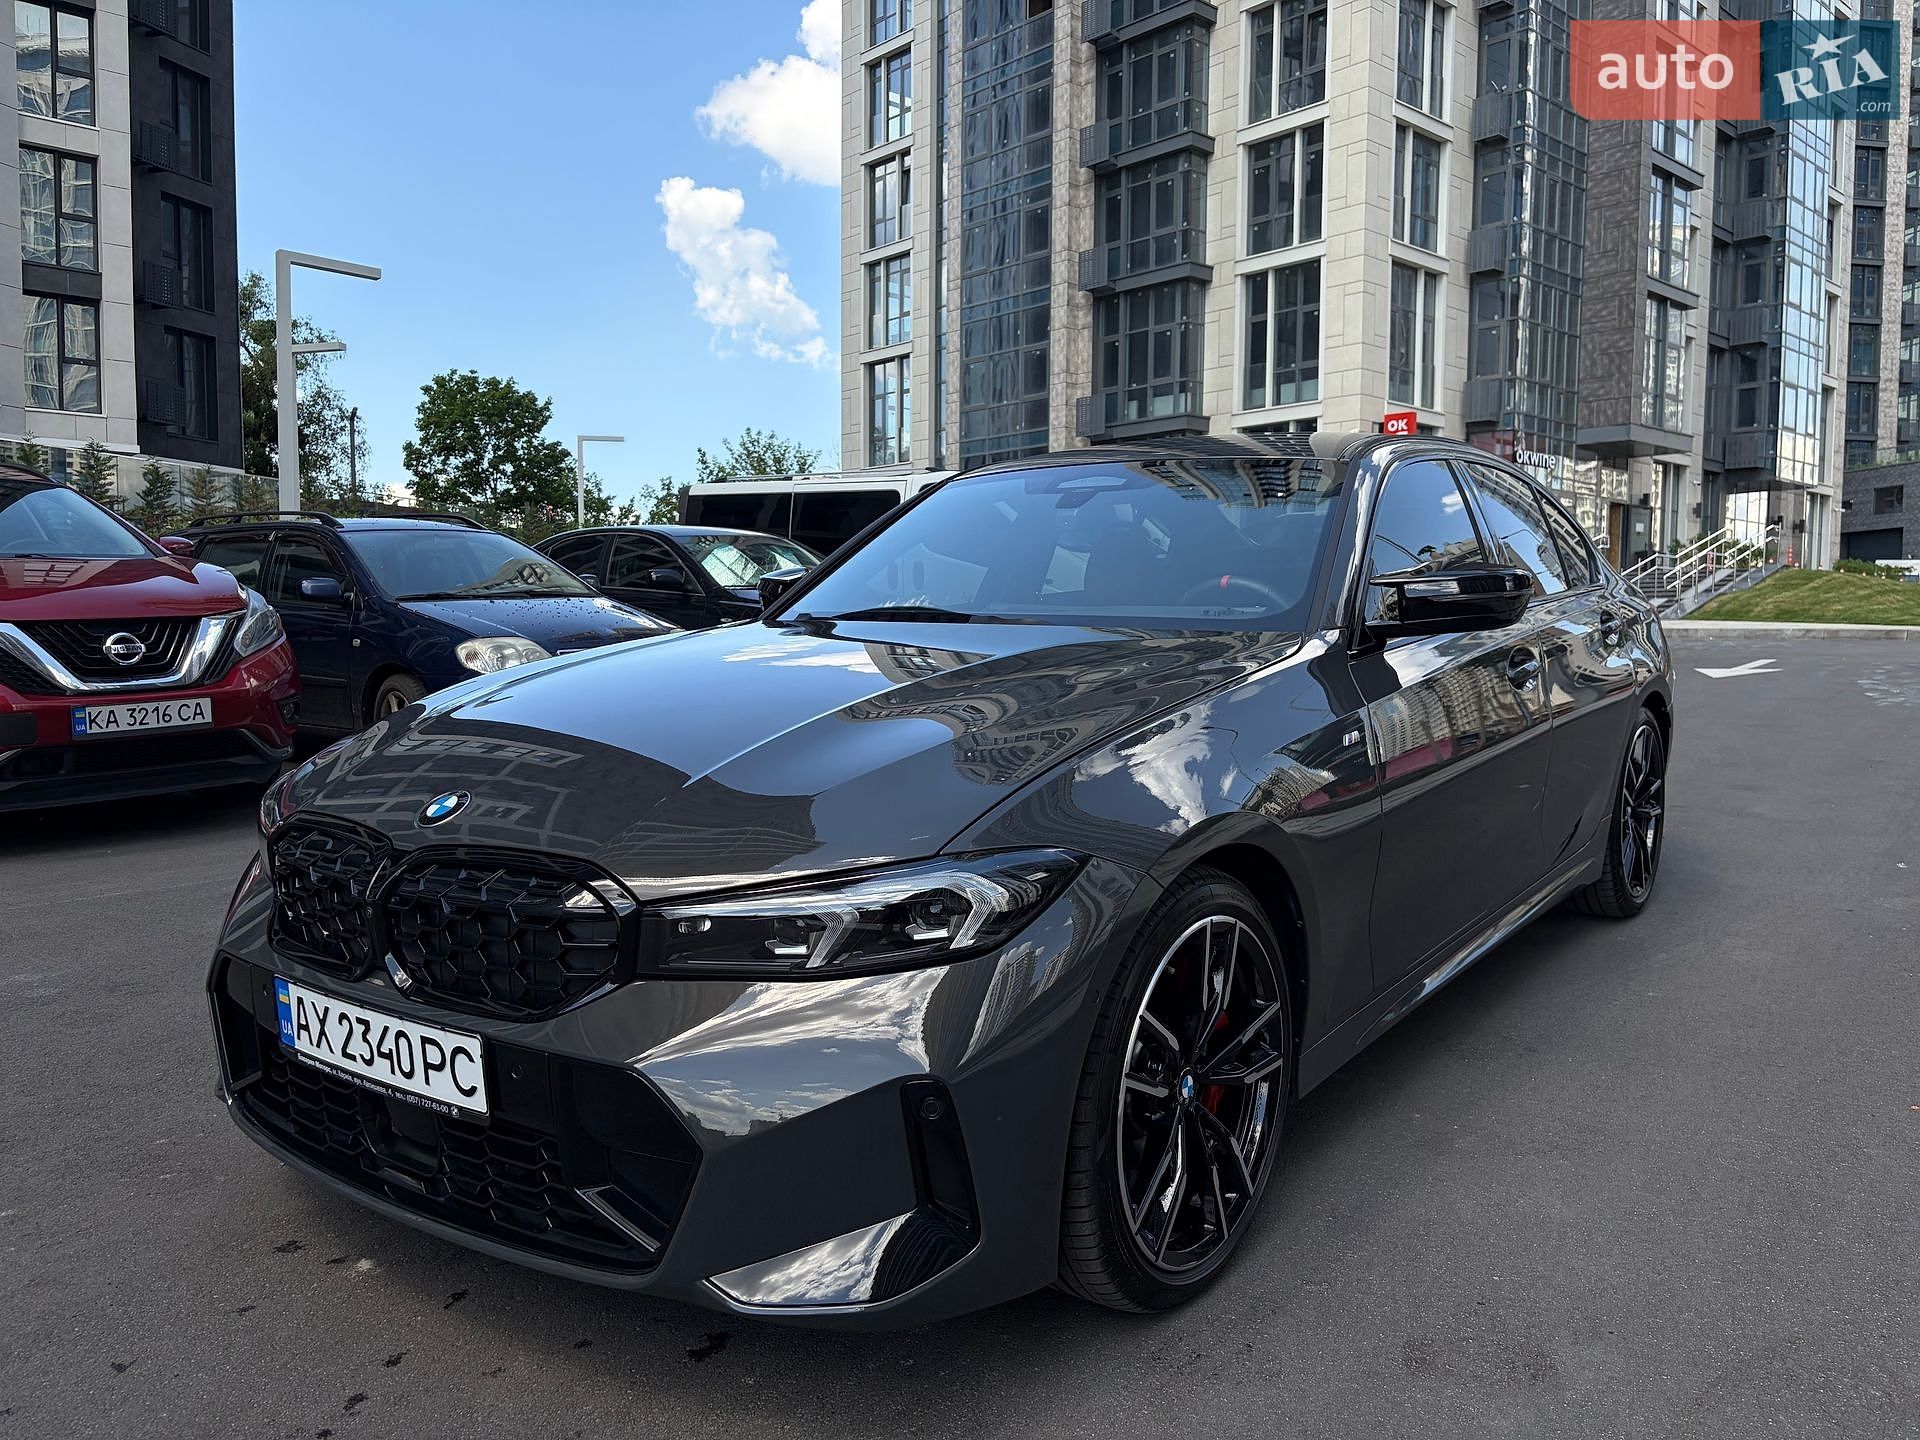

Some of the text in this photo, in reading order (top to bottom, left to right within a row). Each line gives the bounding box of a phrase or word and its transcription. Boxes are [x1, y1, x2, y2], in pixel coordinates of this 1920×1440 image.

[1388, 418, 1409, 432] OK
[88, 701, 206, 731] KA 3216 CA
[281, 1021, 294, 1037] UA
[296, 995, 479, 1098] AX 2340 PC
[406, 1094, 421, 1106] (057)
